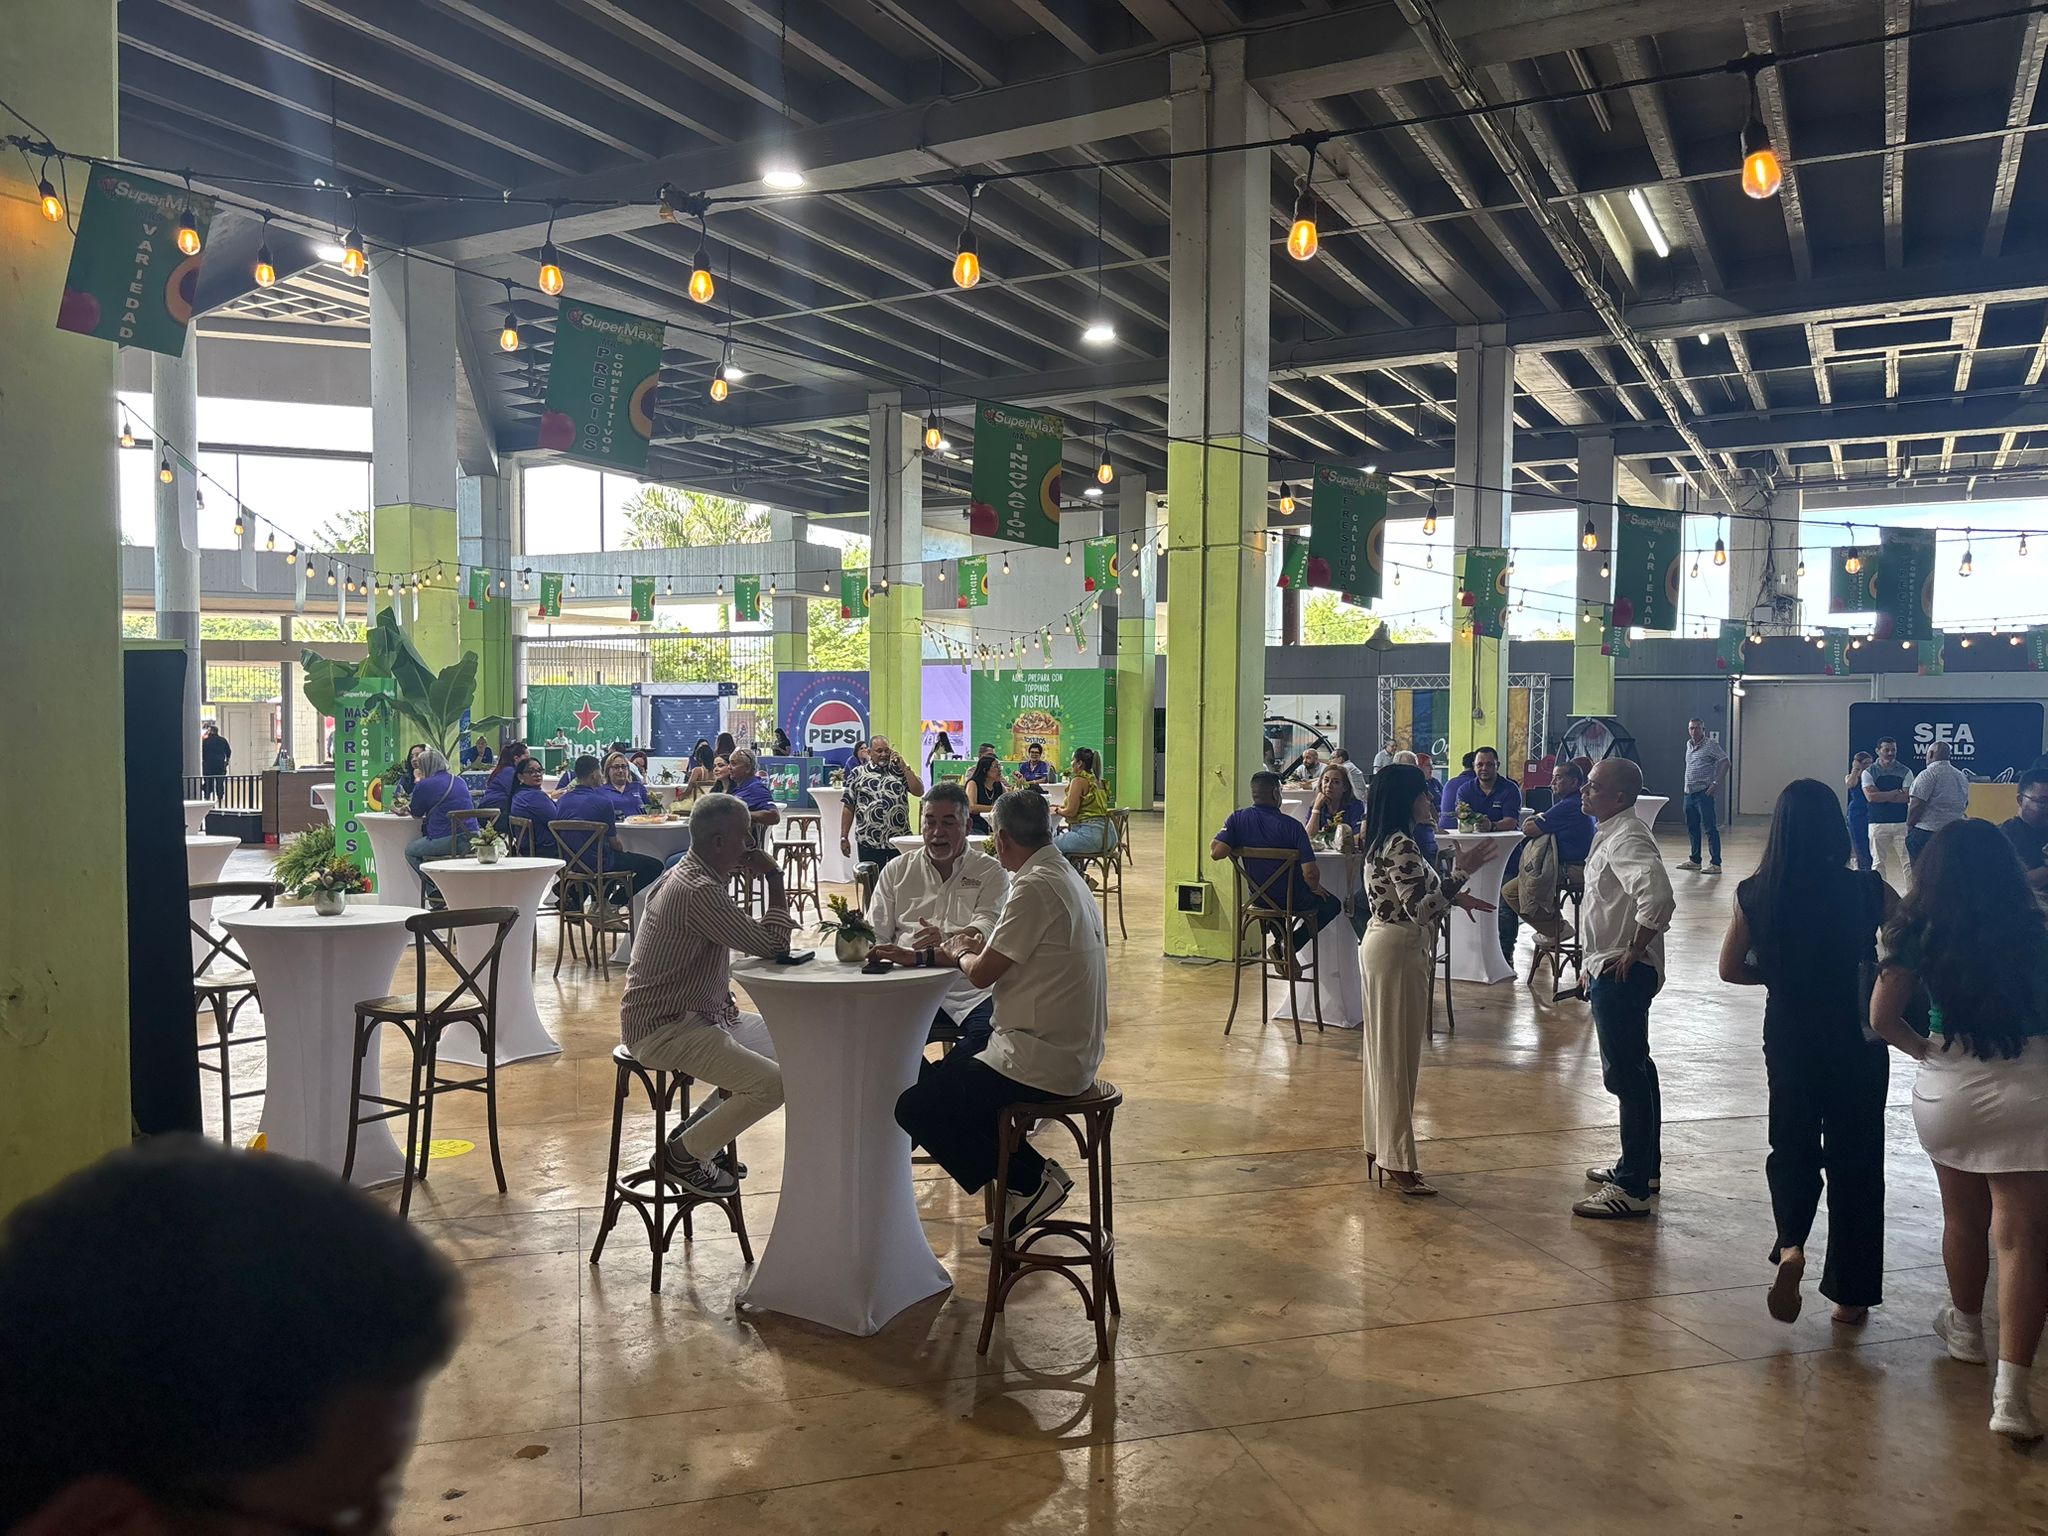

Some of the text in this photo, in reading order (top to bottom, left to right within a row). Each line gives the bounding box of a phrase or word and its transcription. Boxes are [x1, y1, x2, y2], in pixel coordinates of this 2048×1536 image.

[119, 223, 157, 339] VARIEDAD
[580, 312, 654, 342] SuperMax
[582, 345, 611, 451] PRECIOS
[601, 352, 625, 454] COMPETITIVOS
[994, 410, 1056, 434] SuperMax
[1327, 470, 1380, 490] SuperMax
[1629, 513, 1679, 528] SuperMax
[1349, 513, 1359, 582] CALIDAD
[1643, 540, 1657, 625] VARIEDAD
[1027, 673, 1050, 683] PREPARA
[1051, 673, 1064, 683] CON
[1012, 694, 1060, 709] Y DISFRUTA
[809, 728, 861, 744] PEPSI
[1913, 722, 1975, 743] SEA
[343, 719, 358, 853] PRECIOS
